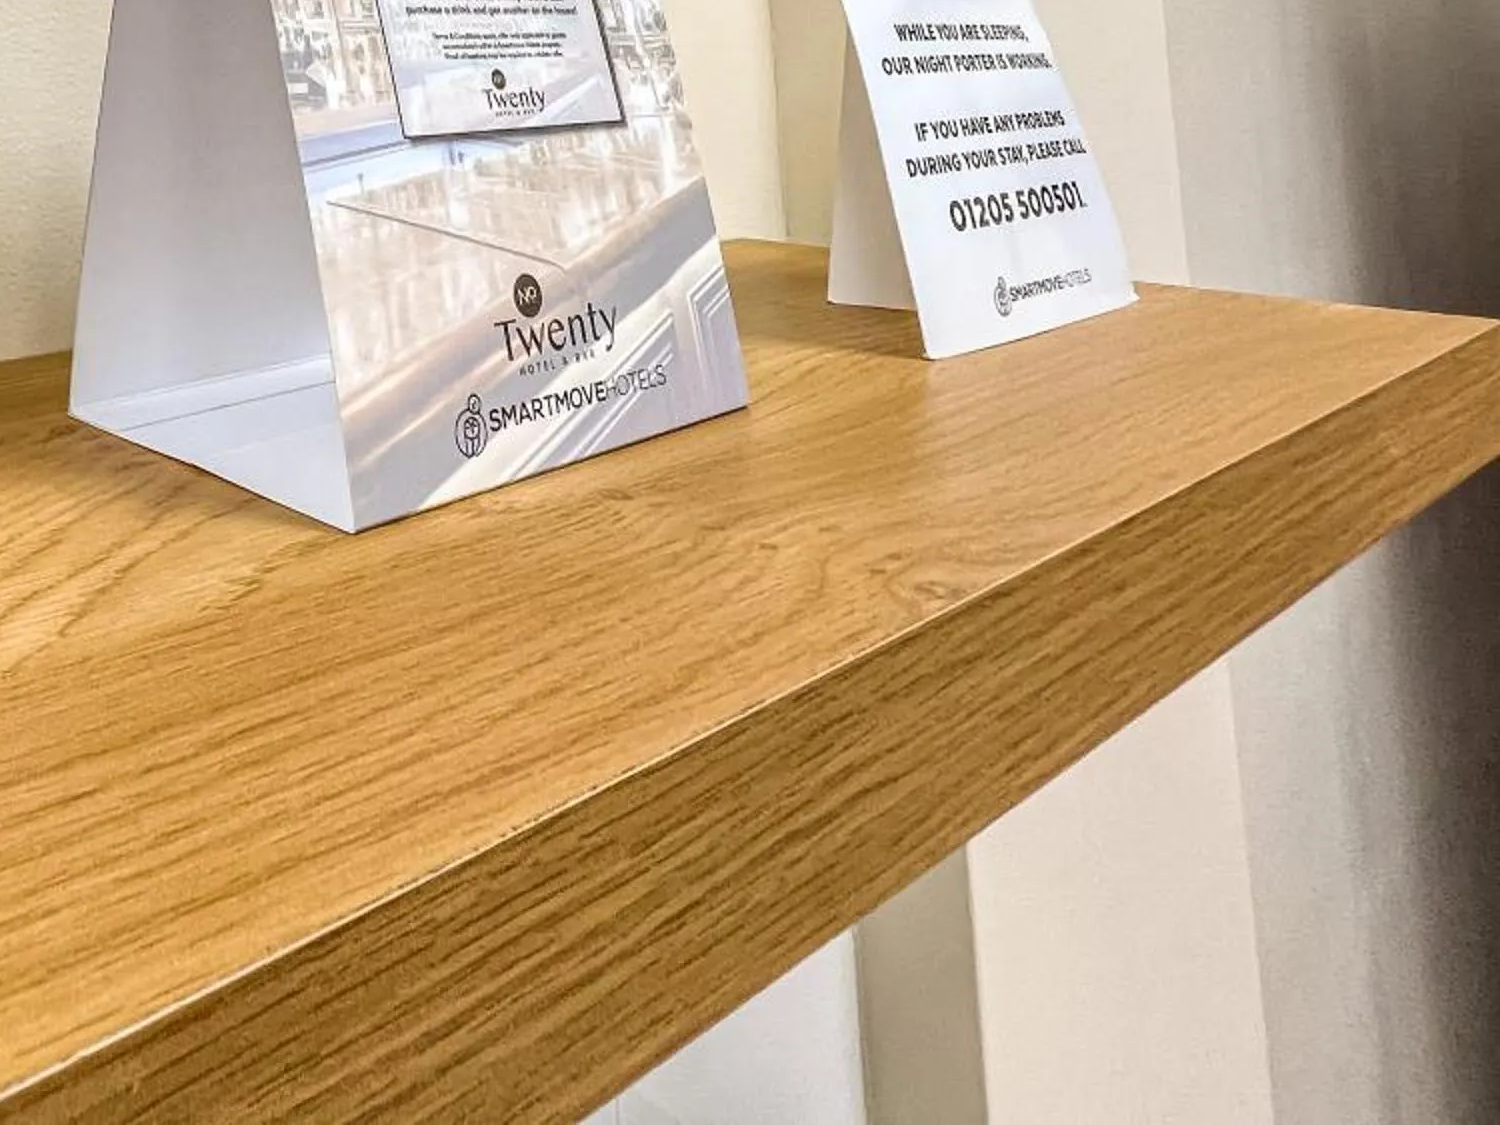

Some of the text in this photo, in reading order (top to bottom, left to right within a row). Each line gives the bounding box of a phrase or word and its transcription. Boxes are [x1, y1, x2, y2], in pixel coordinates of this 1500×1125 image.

[893, 24, 937, 42] WHILE
[935, 24, 959, 41] YOU
[959, 24, 981, 41] ARE
[881, 56, 913, 76] OUR
[913, 54, 954, 74] NIGHT
[953, 53, 997, 72] PORTER
[996, 53, 1008, 69] IS
[482, 86, 546, 114] Twenty
[914, 110, 1066, 142] IF YOU HAVE ANY PROBLEMS
[905, 138, 1088, 178] DURING YOUR STAY, PLEASE CALL
[949, 180, 1087, 232] 01205 500501
[494, 302, 617, 362] Twenty
[520, 361, 556, 377] HOTEL
